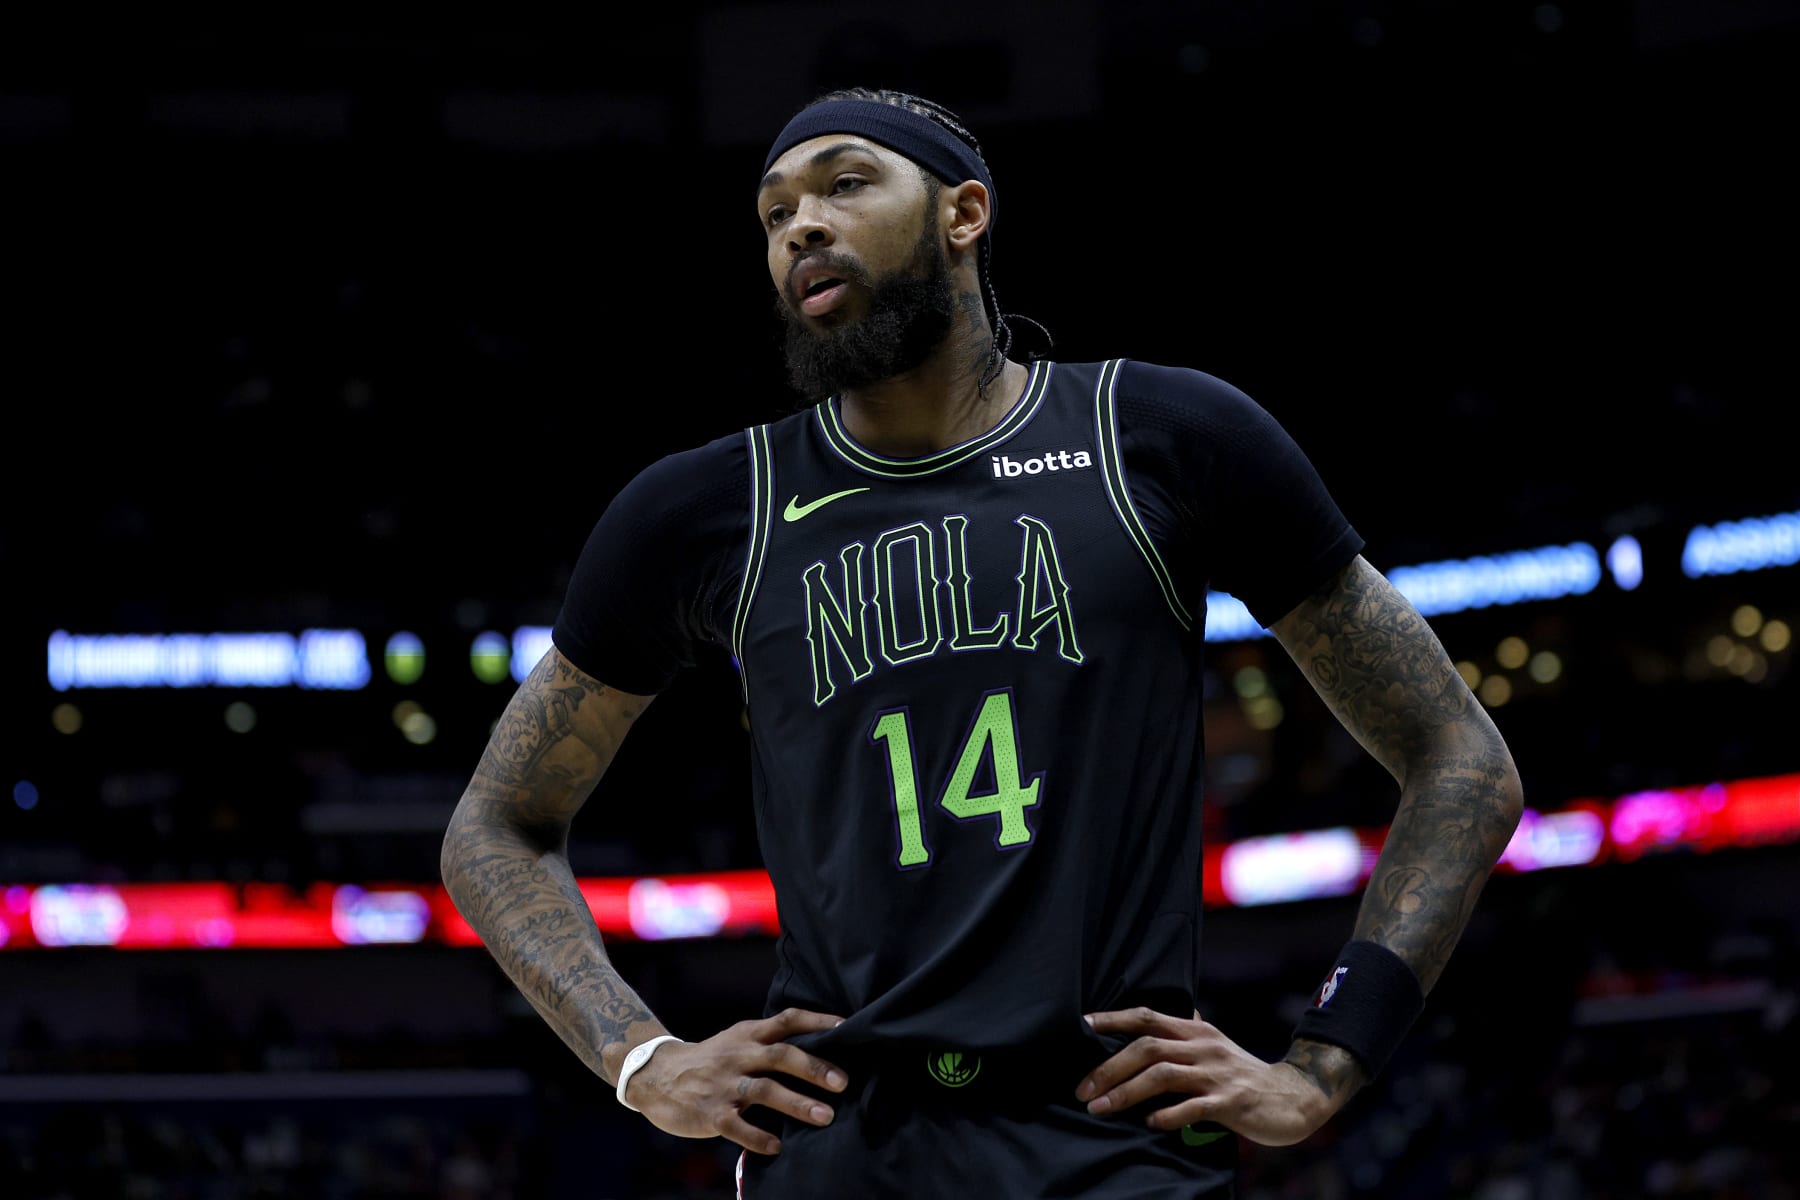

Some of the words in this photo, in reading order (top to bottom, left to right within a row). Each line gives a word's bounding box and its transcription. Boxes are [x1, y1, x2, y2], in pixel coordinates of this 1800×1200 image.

[991, 449, 1092, 478] ibotta
[803, 513, 1086, 706] NOLA
[870, 690, 1043, 868] 14
